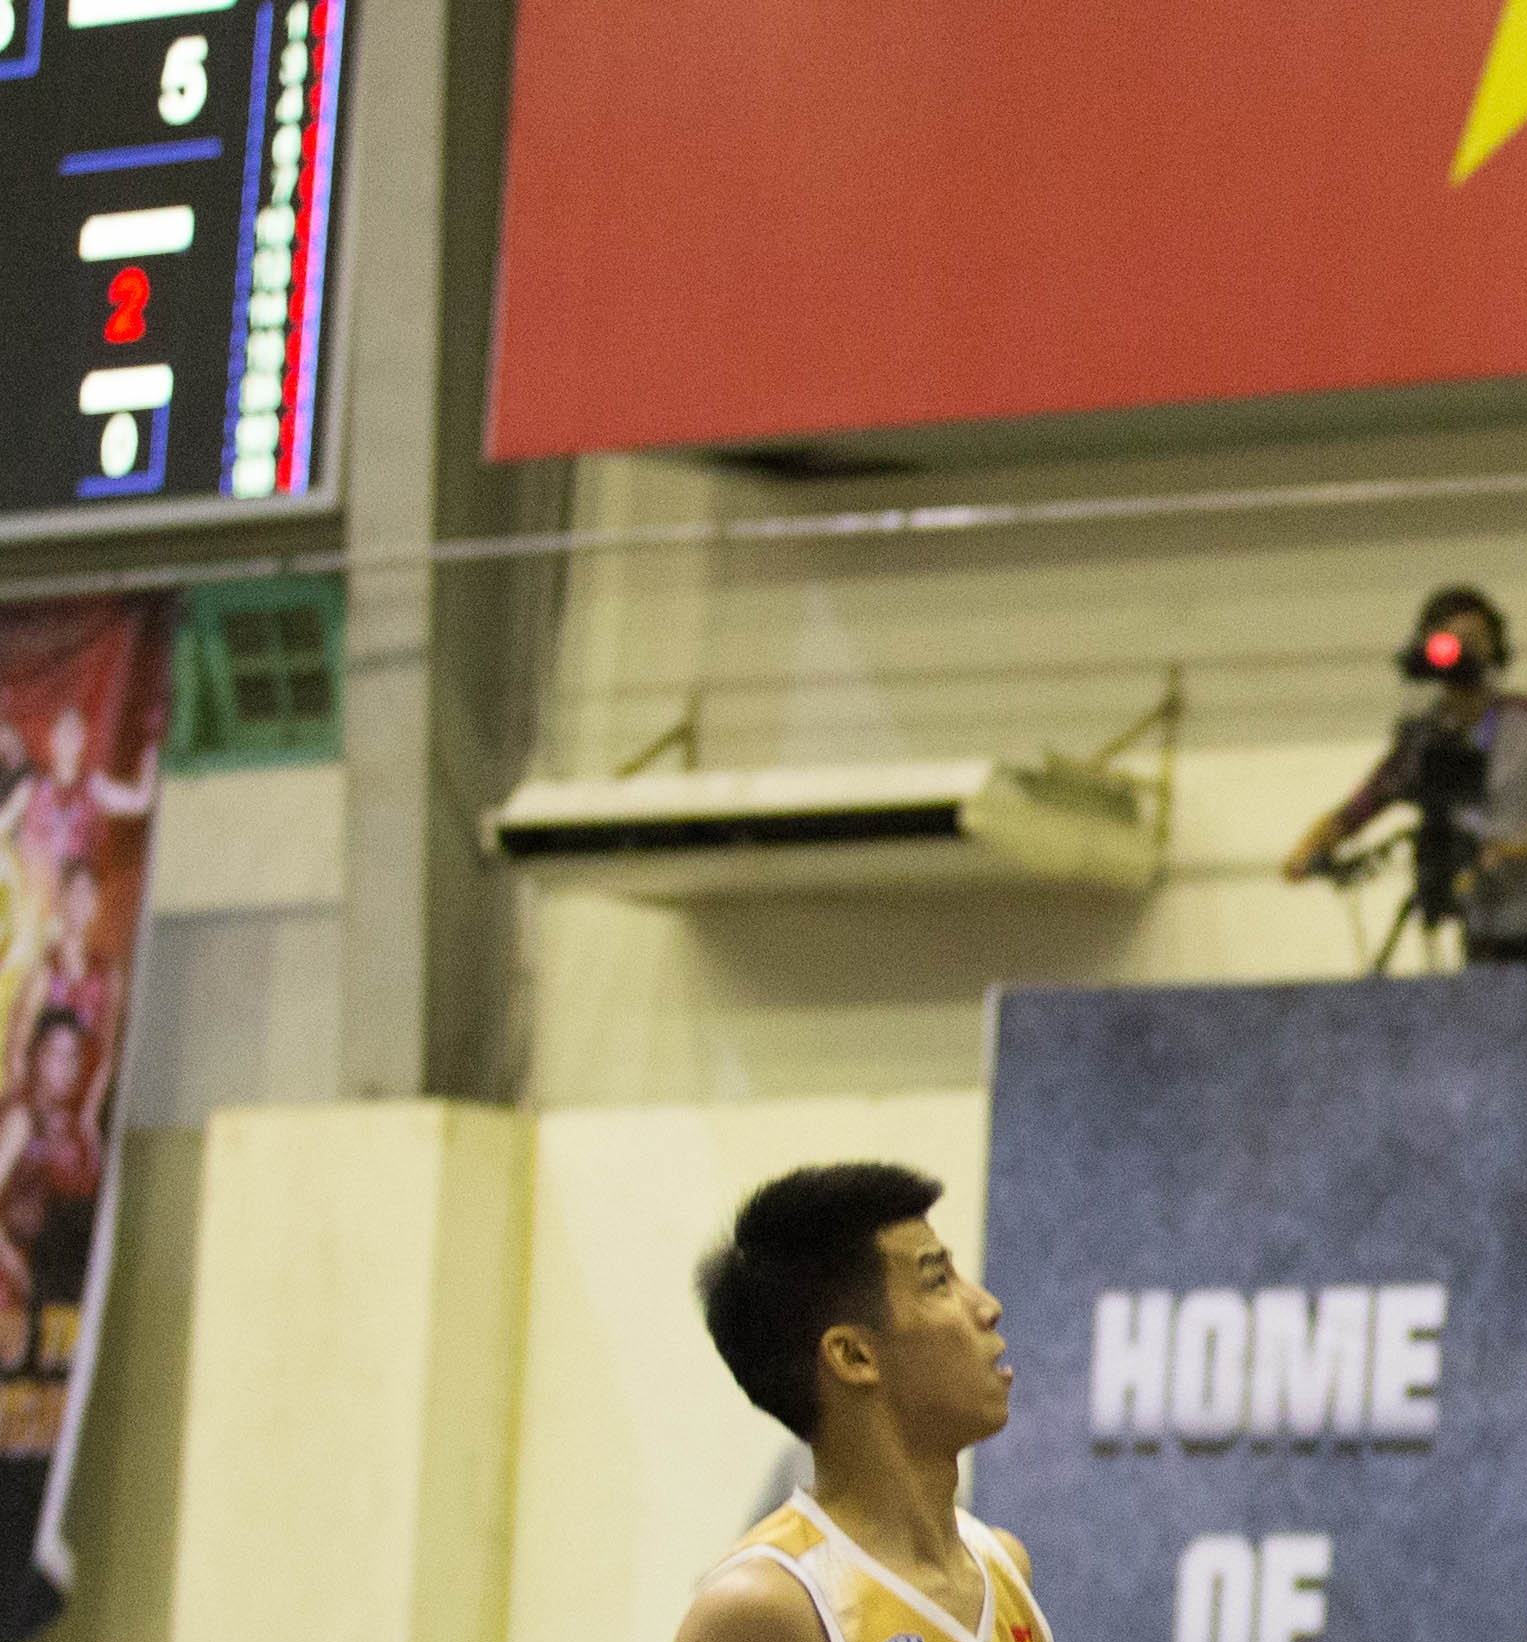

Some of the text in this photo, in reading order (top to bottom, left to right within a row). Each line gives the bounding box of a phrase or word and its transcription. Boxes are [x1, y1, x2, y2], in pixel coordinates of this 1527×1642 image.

[158, 34, 208, 126] 5
[104, 266, 149, 344] 2
[1090, 1283, 1448, 1440] HOME
